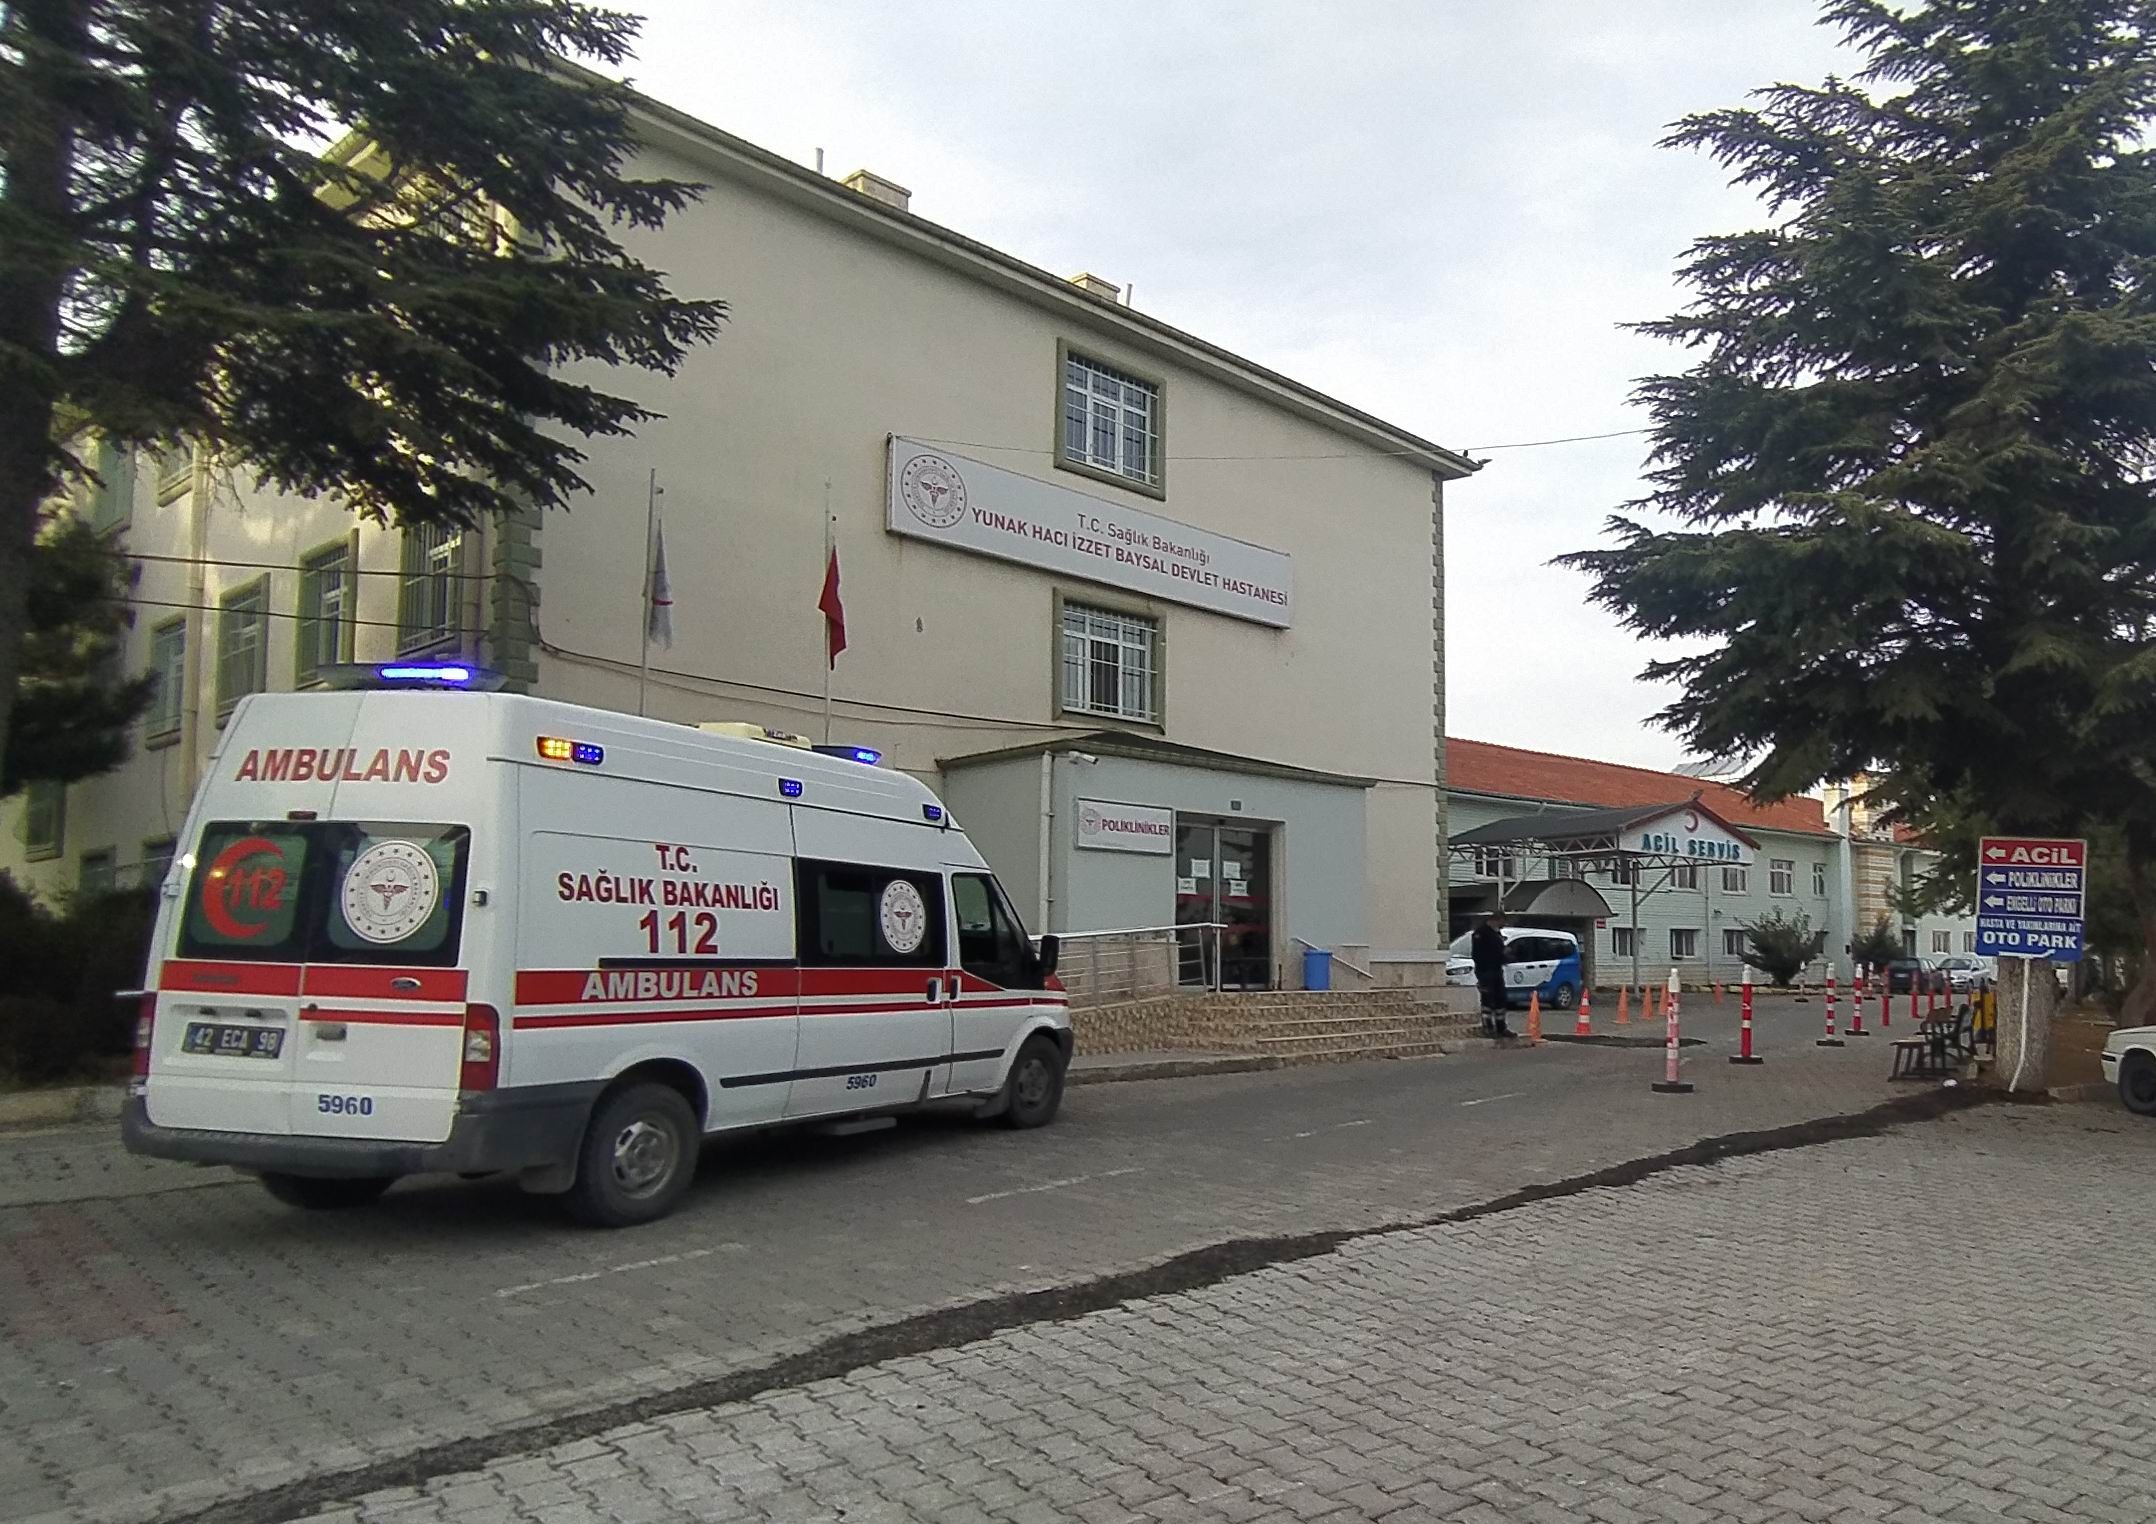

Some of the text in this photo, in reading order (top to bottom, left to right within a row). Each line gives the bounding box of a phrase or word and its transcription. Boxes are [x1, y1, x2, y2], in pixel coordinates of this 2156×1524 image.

[1077, 513, 1210, 566] T.C. Sağlık Bakanlığı
[972, 507, 1288, 606] YUNAK HACI İZZET BAYSAL DEVLET HASTANESİ
[235, 748, 451, 784] AMBULANS
[655, 844, 698, 872] T.C.
[1687, 839, 1740, 860] SERVİS
[228, 866, 288, 911] 112
[558, 868, 779, 911] SAĞLIK BAKANLIĞI
[639, 909, 718, 954] 112
[1983, 931, 2078, 949] OTO PARK
[581, 970, 758, 1000] AMBULANS
[846, 1074, 877, 1090] 5960
[318, 1094, 374, 1116] 5960
